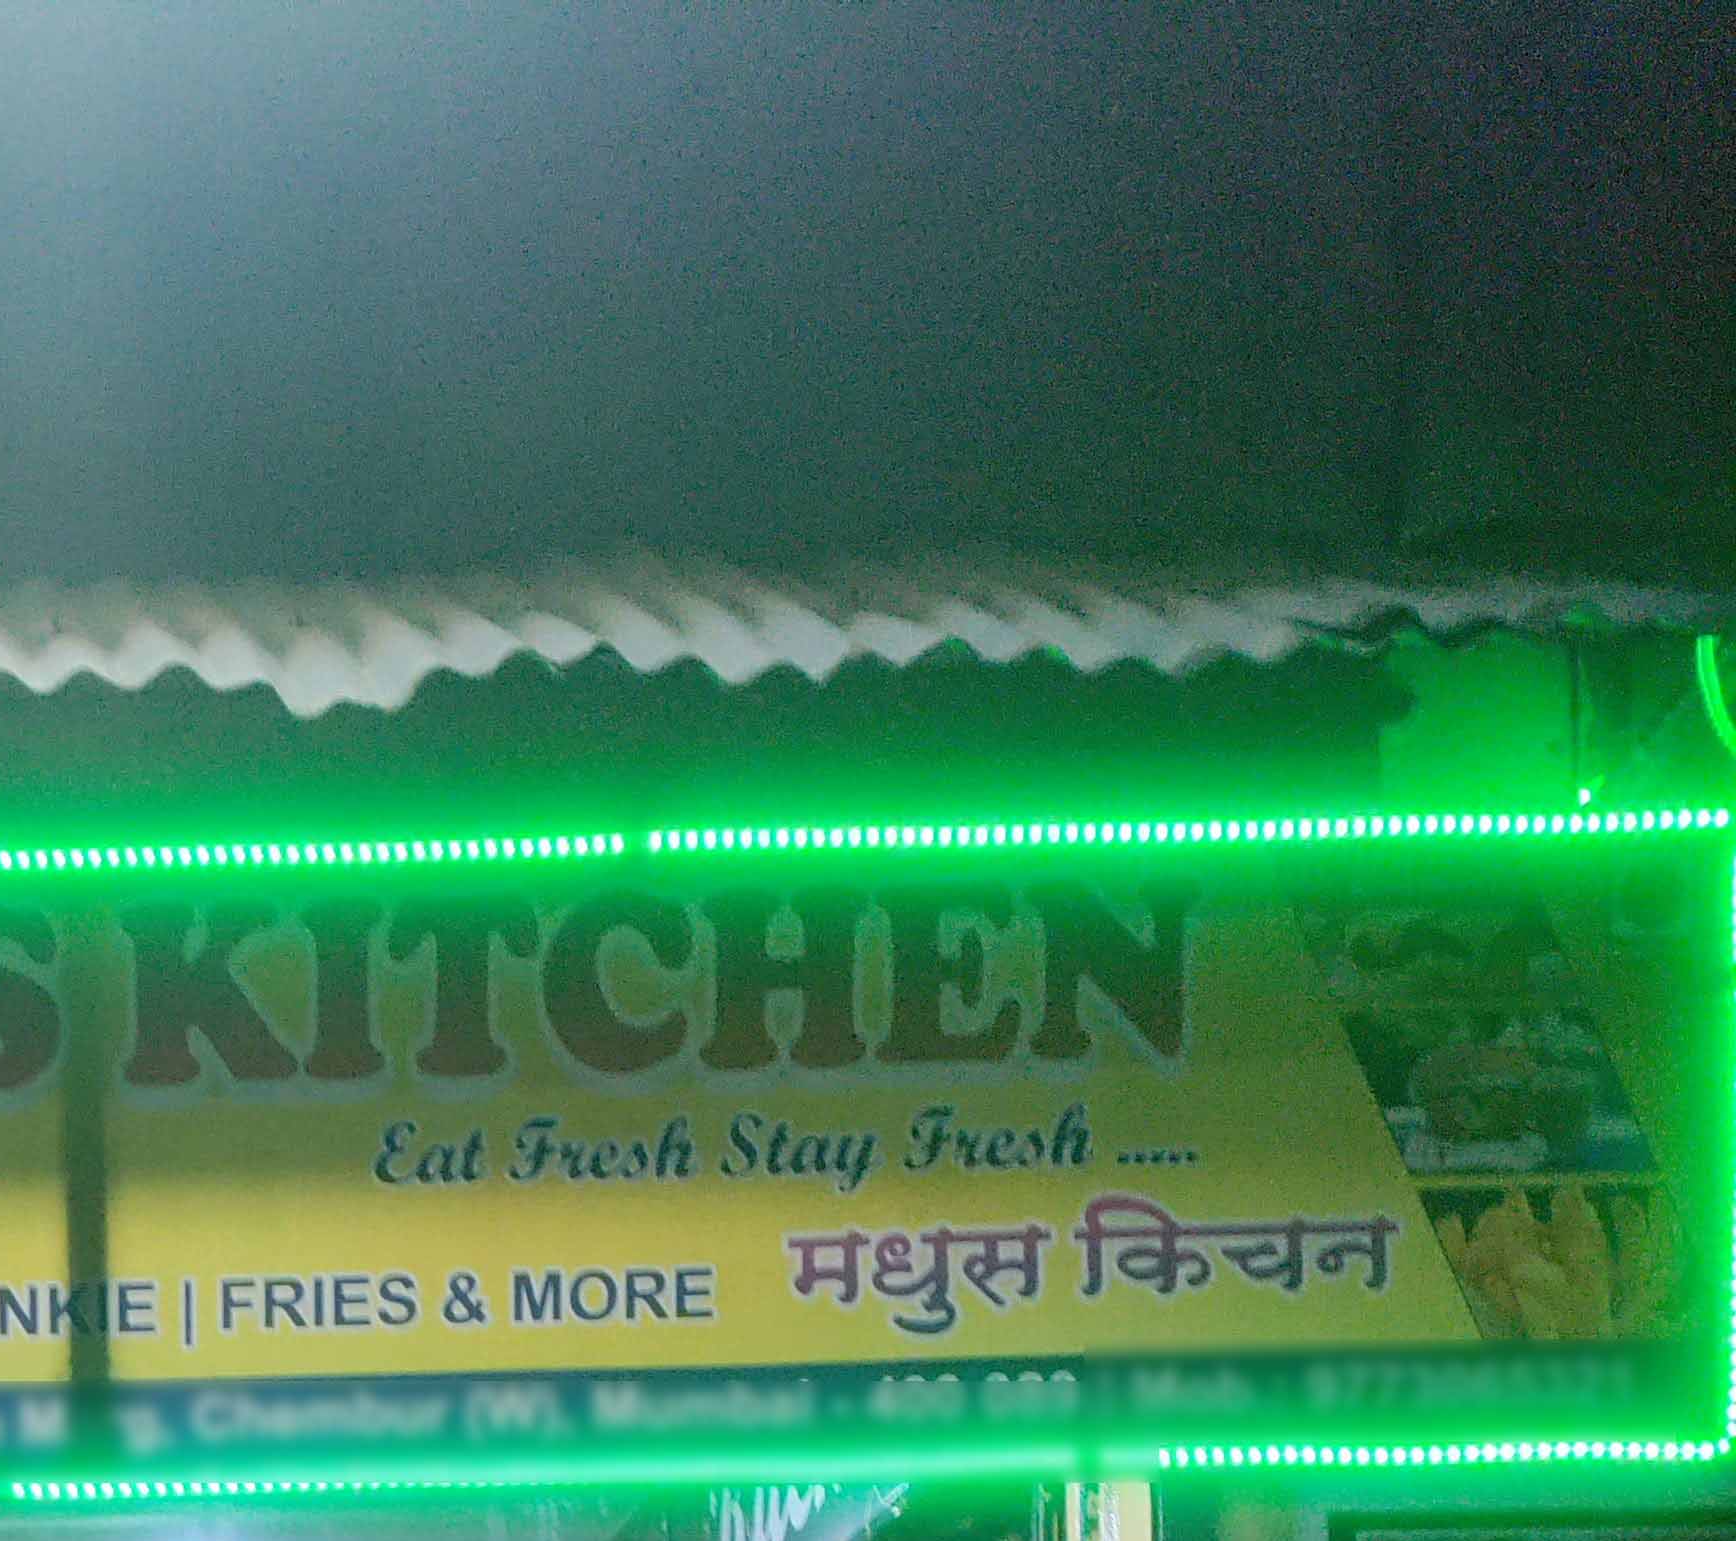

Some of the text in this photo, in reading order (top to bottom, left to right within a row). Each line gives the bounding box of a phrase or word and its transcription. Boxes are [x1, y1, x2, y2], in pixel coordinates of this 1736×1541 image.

[121, 880, 1196, 1097] KITCHEN
[373, 1119, 487, 1184] Eat
[509, 1111, 696, 1184] Fresh
[719, 1110, 880, 1192] Stay
[904, 1103, 1094, 1172] Fresh
[220, 1272, 418, 1330] FRIES
[442, 1269, 487, 1326] &
[512, 1266, 714, 1323] MORE
[787, 1193, 1401, 1335] मधुस किचन
